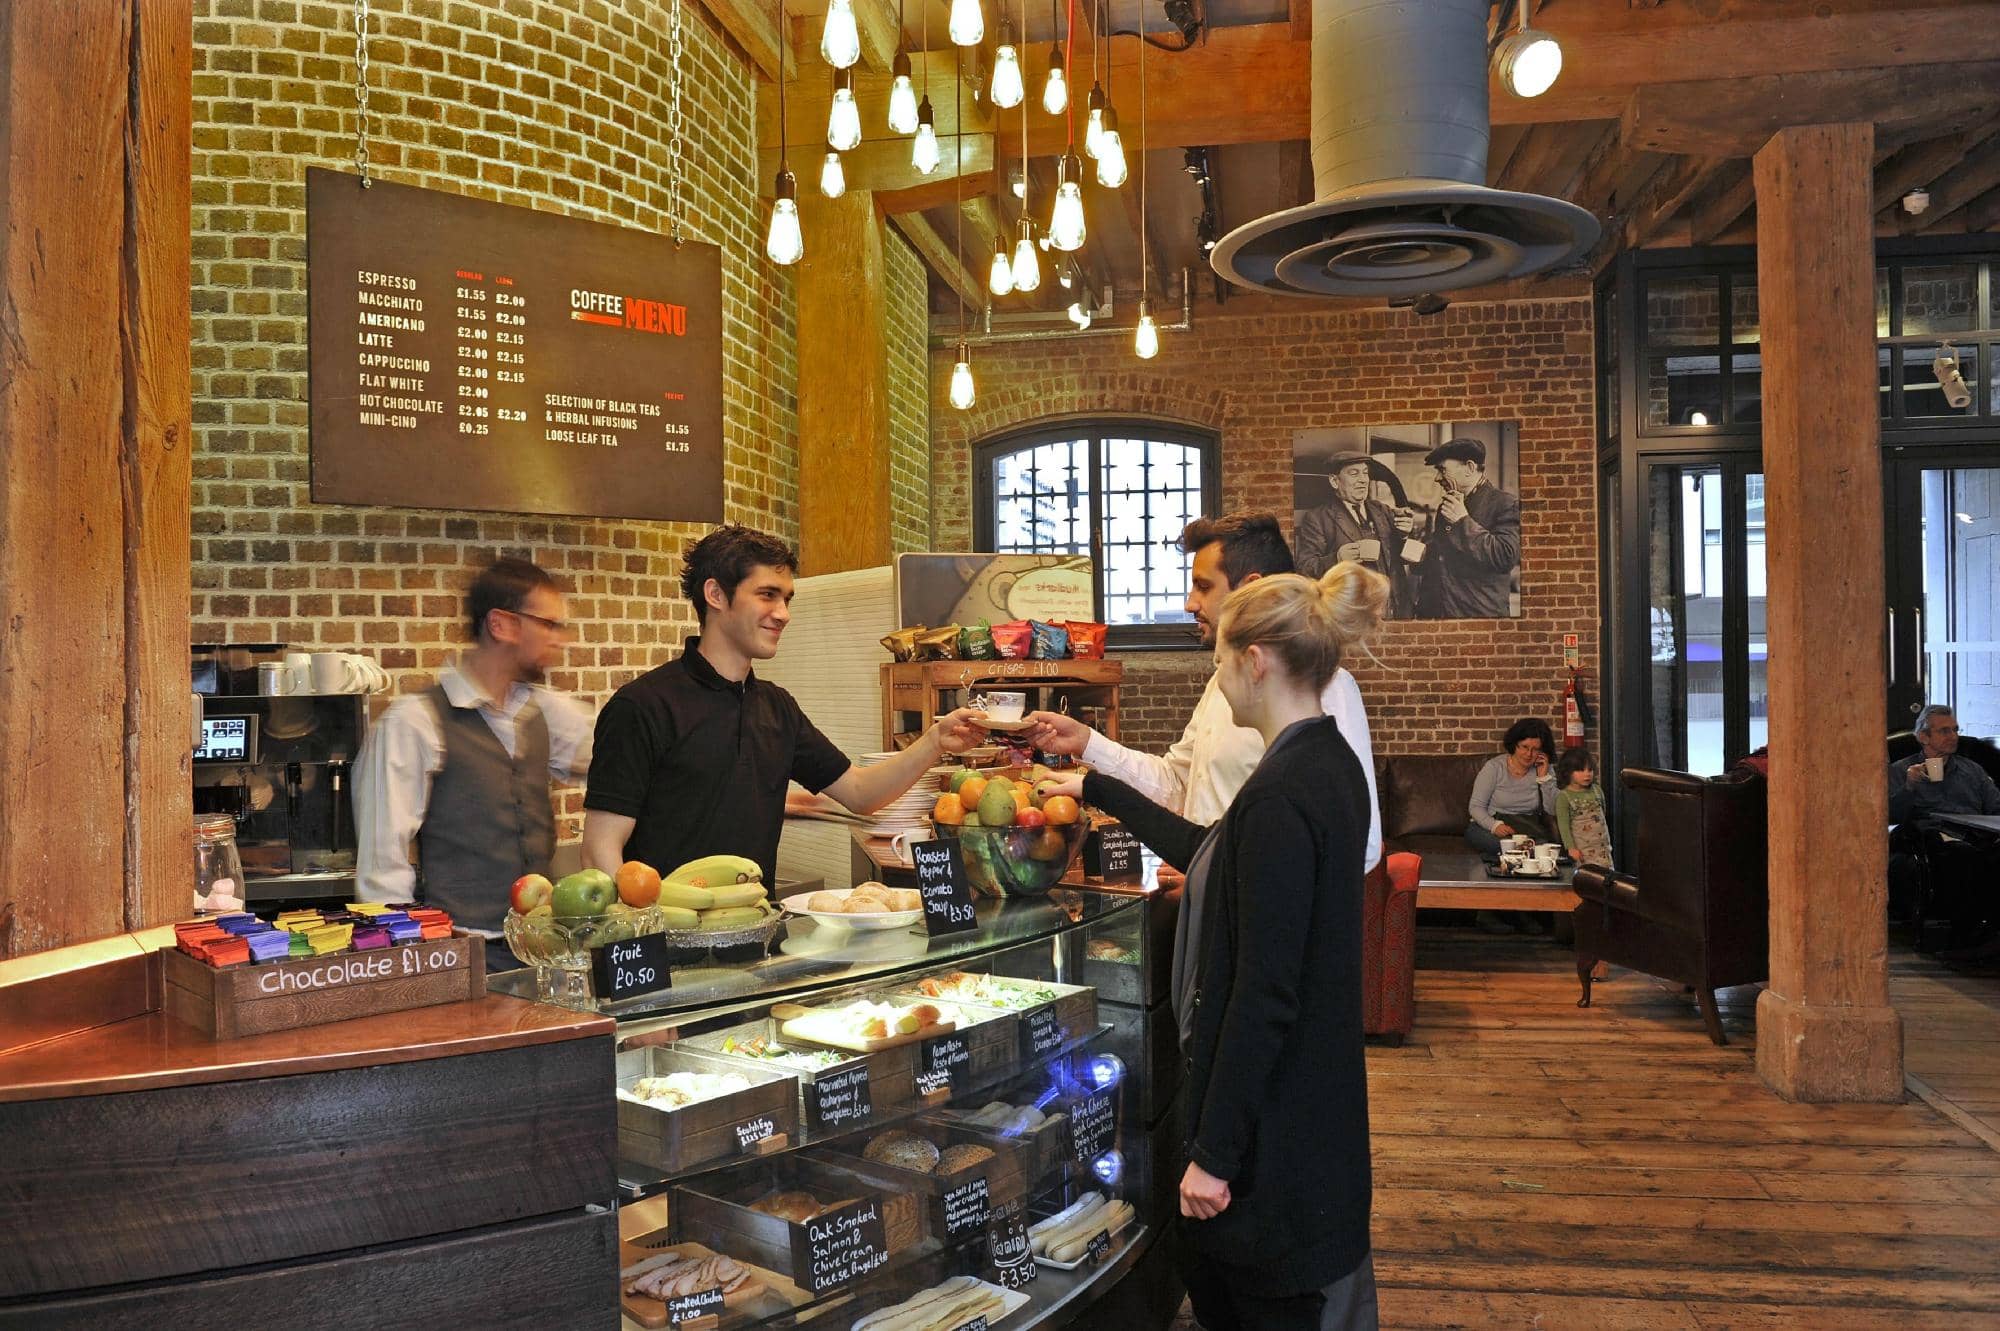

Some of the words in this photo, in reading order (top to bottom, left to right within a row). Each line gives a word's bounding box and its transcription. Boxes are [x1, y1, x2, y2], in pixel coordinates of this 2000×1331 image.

[358, 271, 416, 290] ESPRESSO
[457, 287, 486, 301] £1.55
[496, 293, 526, 307] £2.00
[358, 291, 422, 312] MACCHIATO
[457, 307, 486, 321] £1.55
[496, 312, 526, 326] £2.00
[571, 289, 622, 315] COFFEE
[625, 297, 688, 336] MENU
[359, 312, 424, 332] AMERICANO
[458, 327, 488, 340] £2.00
[496, 332, 524, 345] £2.15
[358, 332, 394, 348] LATTE
[458, 346, 488, 360] £2.00
[496, 351, 524, 364] £2.15
[359, 353, 430, 372] CAPPUCCINO
[458, 366, 488, 379] £2.00
[496, 370, 525, 384] £2.15
[360, 373, 387, 388] FLAT
[390, 376, 425, 392] WHITE
[458, 386, 488, 399] £2.00
[360, 394, 381, 407] HOT
[383, 396, 444, 413] CHOCOLATE
[459, 405, 488, 418] £2.05
[497, 408, 527, 422] £2.20
[545, 394, 593, 410] SELECTION
[596, 399, 606, 410] OF
[609, 400, 637, 414] BLACK
[640, 403, 661, 416] TEAS
[360, 412, 417, 429] MINI-CINO
[459, 422, 488, 435] £0.25
[546, 410, 553, 422] &
[555, 412, 590, 426] HERBAL
[592, 415, 638, 430] INFUSIONS
[666, 424, 689, 435] £1.55
[546, 429, 574, 442] LOOSE
[577, 432, 599, 444] LEAF
[602, 434, 618, 447] TEA
[666, 441, 690, 452] £1.75
[1033, 664, 1059, 676] £1.00
[915, 846, 950, 863] Roasted
[920, 864, 945, 881] Pepper
[922, 882, 952, 898] tomato
[950, 904, 974, 922] £3.50
[402, 948, 456, 975] £1.00
[611, 944, 642, 964] fruit
[616, 967, 655, 990] £0.50
[1072, 1102, 1088, 1123] Brie
[1088, 1096, 1110, 1115] Cheese
[810, 1222, 834, 1242] Oak
[836, 1203, 877, 1233] Smoked
[813, 1240, 851, 1259] Salmon
[853, 1228, 862, 1245] &
[991, 1224, 1026, 1257] Panini
[813, 1257, 841, 1275] Chive
[842, 1244, 873, 1264] Cream
[815, 1268, 850, 1290] Cheese
[852, 1254, 874, 1274] Bagel
[999, 1263, 1036, 1289] £3.50
[672, 1310, 700, 1324] £1.00
